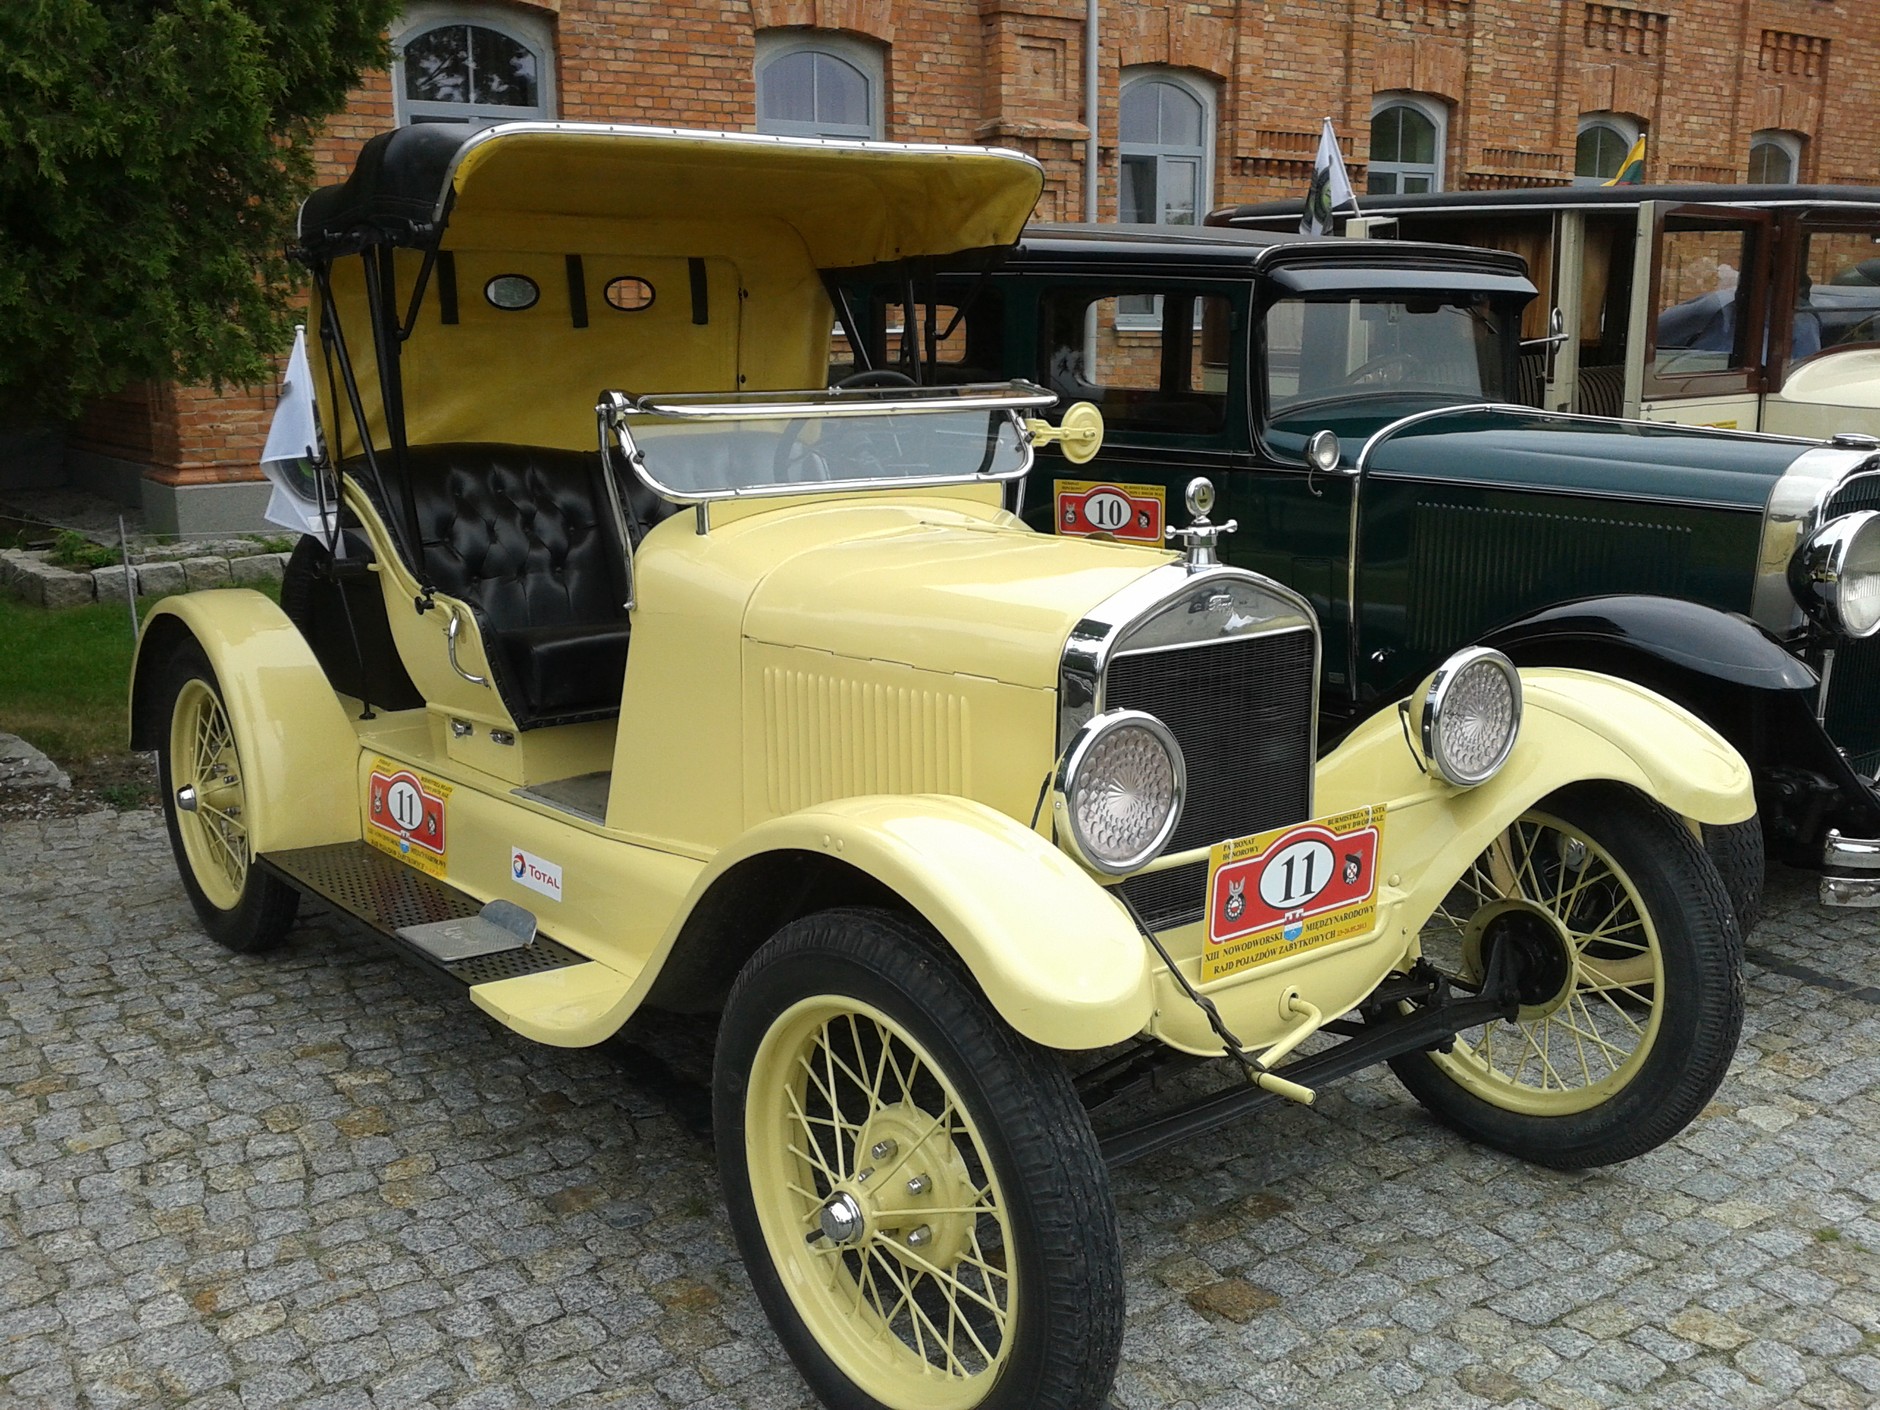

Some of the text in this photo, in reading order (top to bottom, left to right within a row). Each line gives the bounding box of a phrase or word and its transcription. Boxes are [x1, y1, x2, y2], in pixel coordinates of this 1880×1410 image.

[1096, 499, 1122, 526] 10
[397, 789, 414, 827] 11
[1364, 806, 1386, 816] MASTA
[1223, 837, 1255, 852] PARONAT
[528, 863, 560, 890] TOTAL
[1279, 849, 1316, 903] 11
[1205, 904, 1376, 962] XIII NOWODWORSKI MIĘDZYNARODOWY
[1214, 961, 1234, 975] RAJD
[1235, 947, 1278, 968] POJAZDÓW
[1278, 930, 1337, 955] ZABYTKOWYCH
